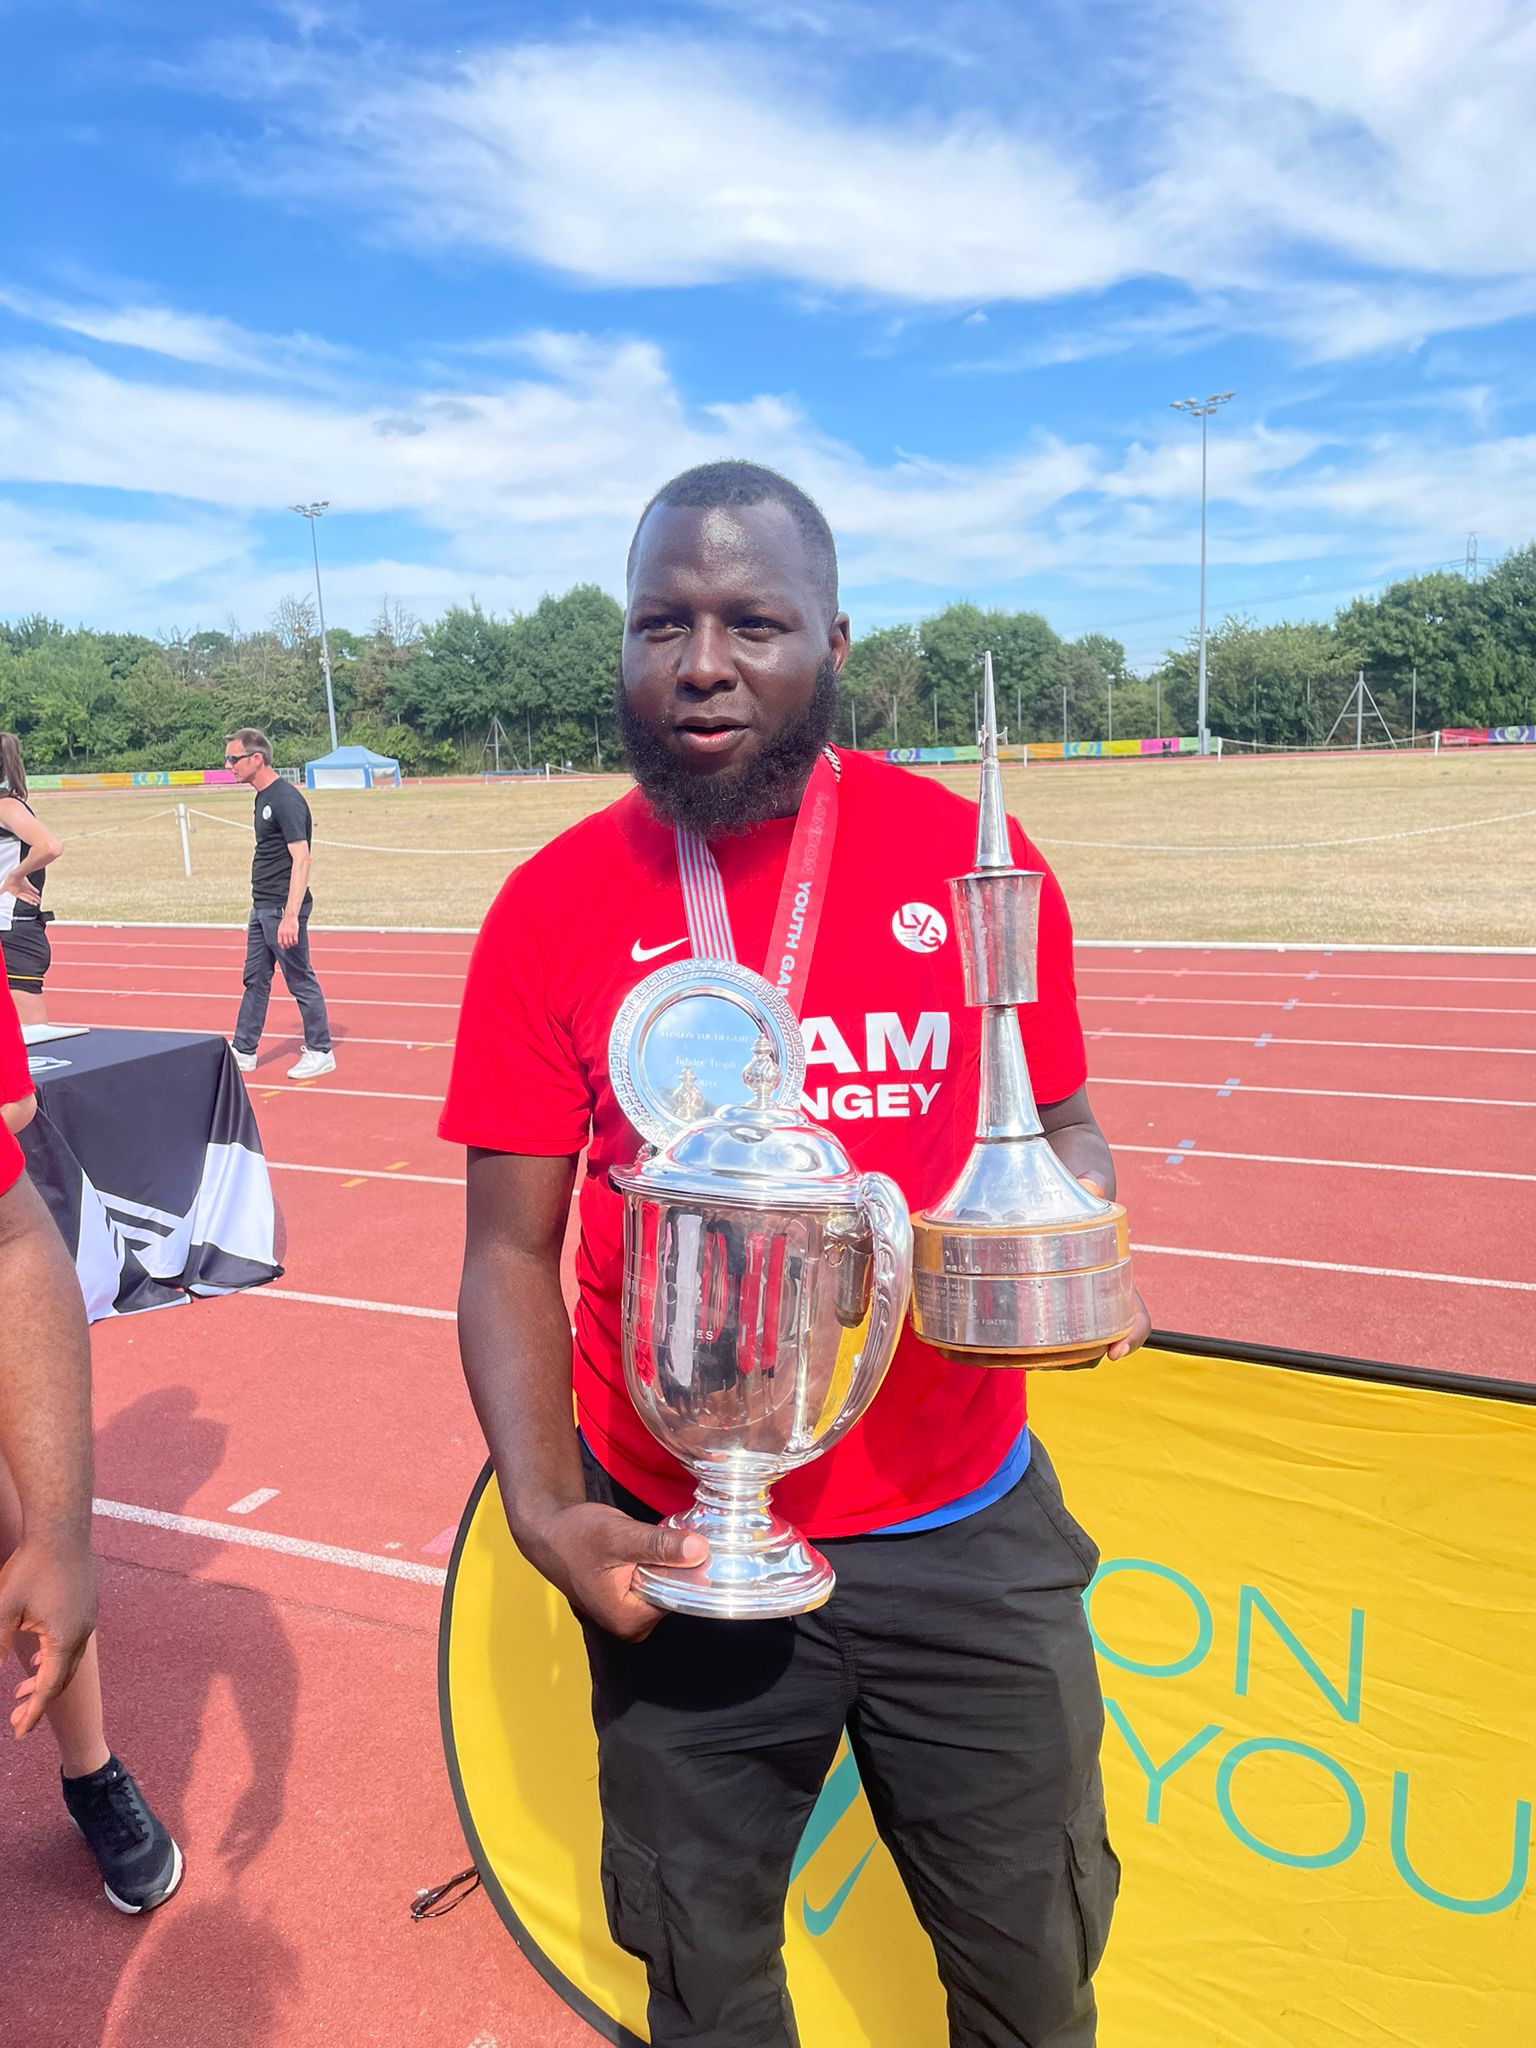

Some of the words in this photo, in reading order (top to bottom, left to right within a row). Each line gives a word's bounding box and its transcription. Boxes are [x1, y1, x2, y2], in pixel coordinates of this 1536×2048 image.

[801, 791, 830, 875] LONDON
[785, 882, 812, 949] YOUTH
[800, 1012, 950, 1073] AM
[800, 1083, 942, 1120] NGEY
[1082, 1558, 1365, 1724] ON
[1102, 1696, 1532, 1915] YOU
